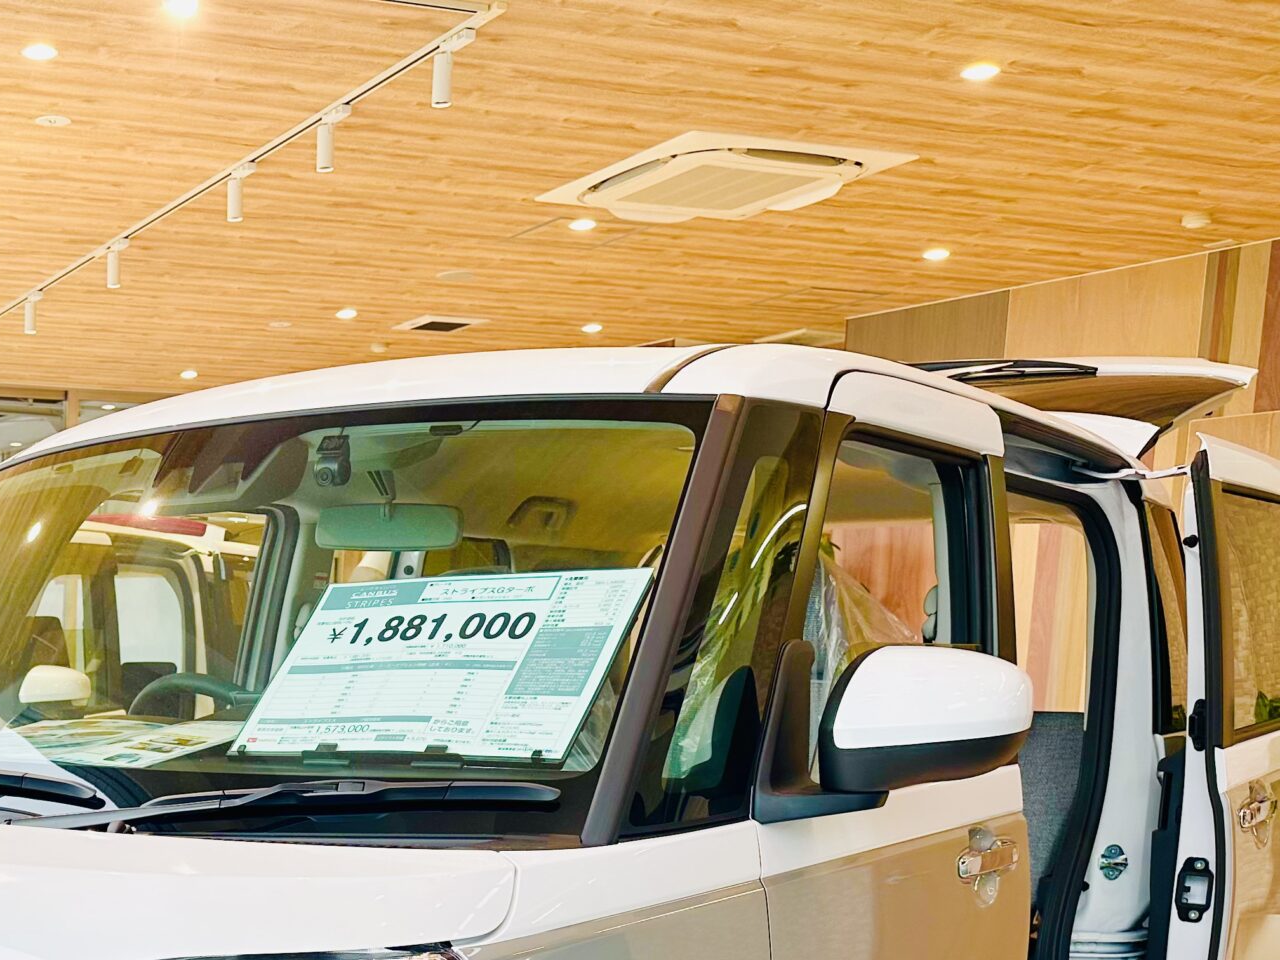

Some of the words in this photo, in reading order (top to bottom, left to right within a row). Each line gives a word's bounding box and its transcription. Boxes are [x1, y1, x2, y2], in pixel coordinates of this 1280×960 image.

[351, 588, 399, 598] CANBUS
[441, 585, 537, 595] ストライプスGターボ
[345, 598, 394, 609] STRIPES
[316, 724, 369, 734] 1,573,000
